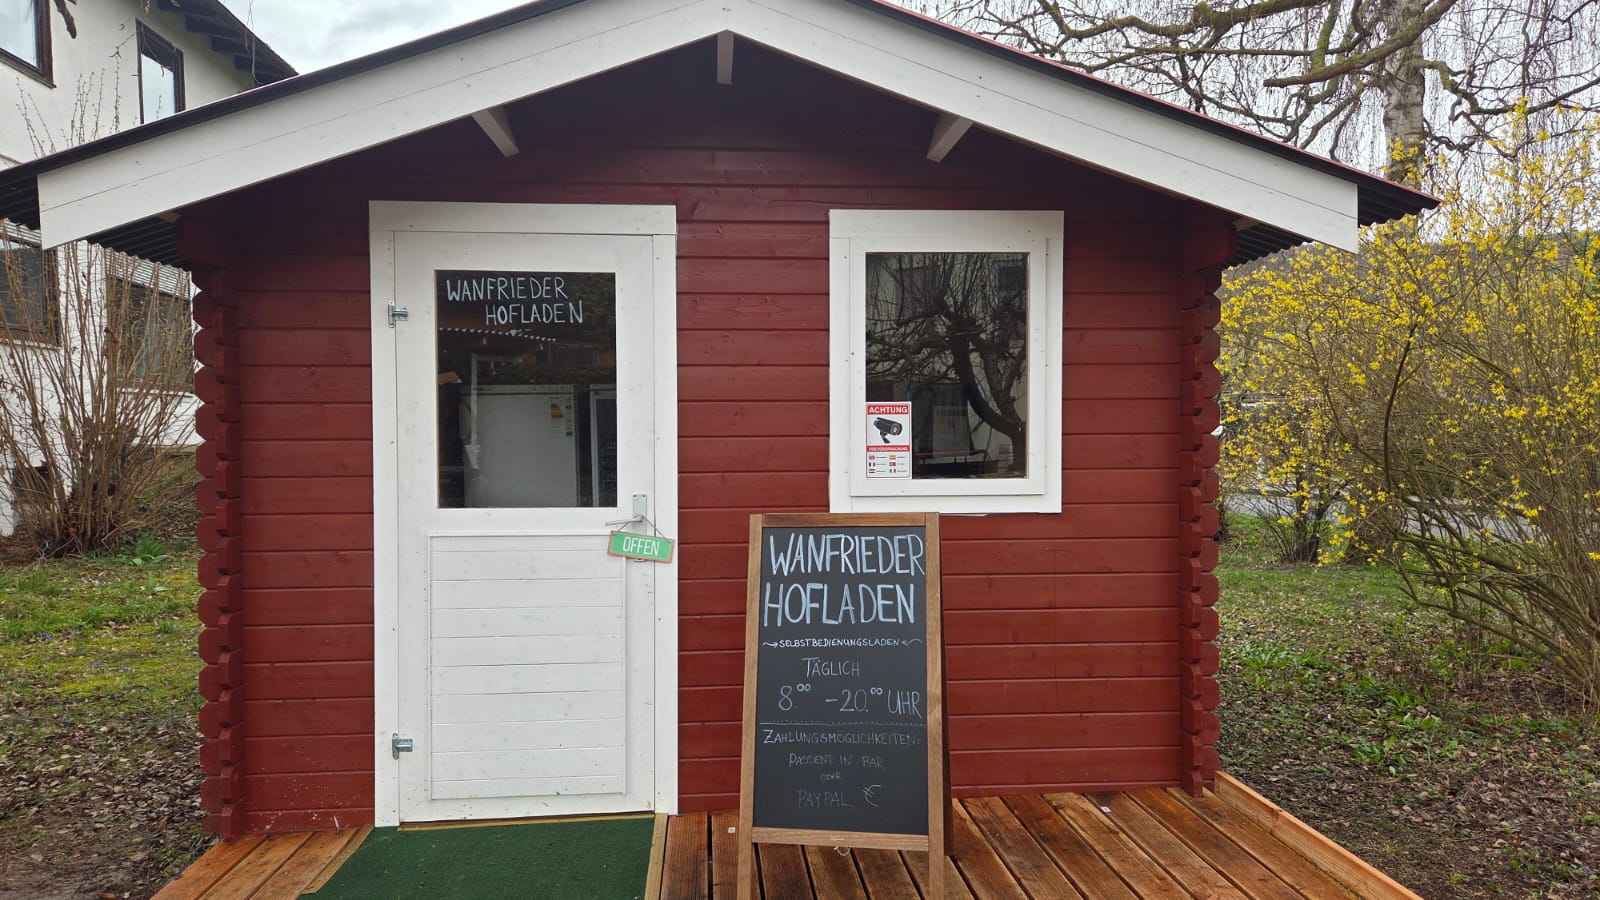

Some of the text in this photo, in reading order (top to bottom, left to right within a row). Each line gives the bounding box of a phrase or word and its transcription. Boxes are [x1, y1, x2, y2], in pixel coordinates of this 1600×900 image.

[446, 276, 568, 301] WANFRIEDER
[485, 300, 583, 325] HOFLADEN
[868, 406, 908, 414] ACHTUNG
[622, 536, 660, 556] OFFEN
[769, 532, 926, 576] WANFRIEDER
[763, 582, 915, 627] HOFLADEN
[779, 638, 900, 648] SELBSTBEDIENUNGSLADEN
[801, 656, 860, 677] TÄGLICH
[887, 689, 922, 719] UHR
[839, 753, 853, 766] IN
